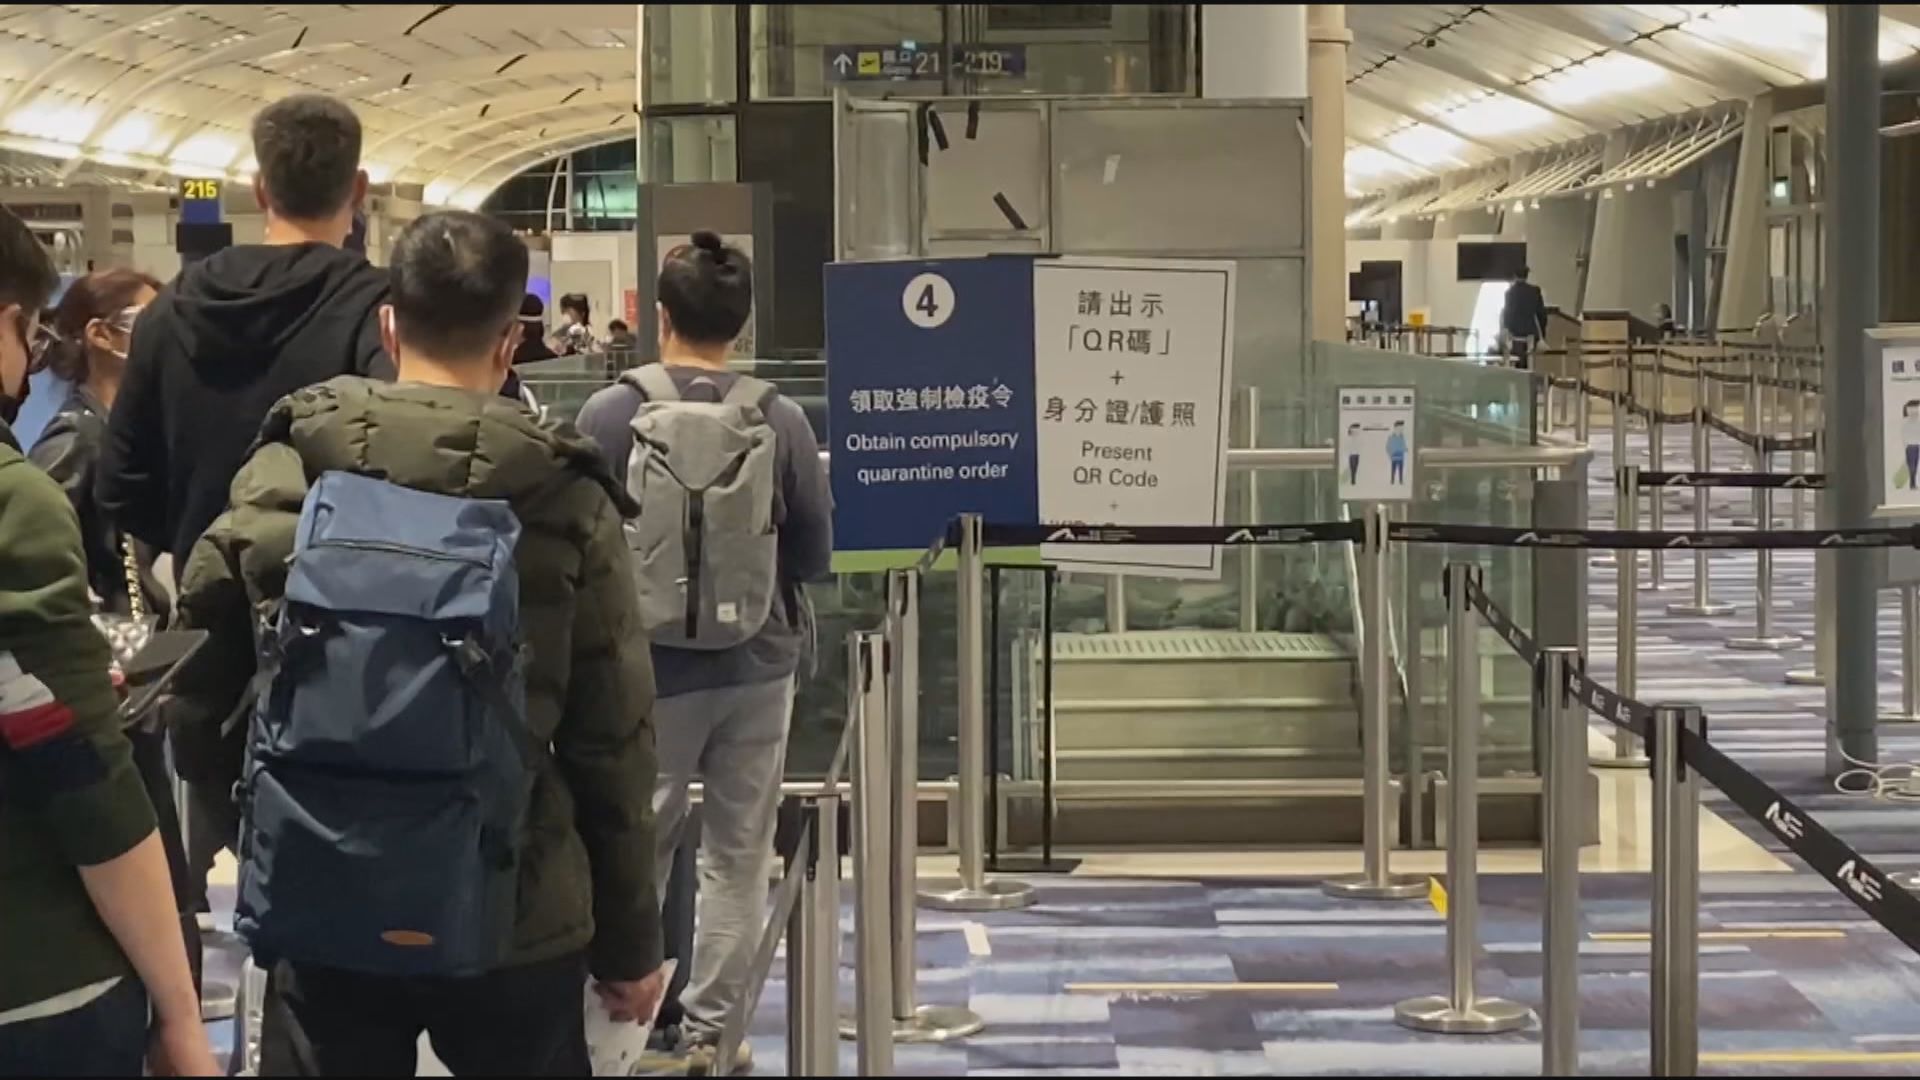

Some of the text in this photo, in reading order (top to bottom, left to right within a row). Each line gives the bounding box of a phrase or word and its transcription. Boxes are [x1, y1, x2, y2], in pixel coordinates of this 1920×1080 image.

[183, 180, 217, 198] 216
[916, 284, 939, 317] 4
[1077, 290, 1164, 318] 請出示
[849, 384, 1013, 413] 領取強制檢疫令
[846, 430, 1019, 452] Obtain compulsory
[1081, 440, 1153, 461] Present
[857, 460, 1009, 486] quarantine order
[1073, 466, 1158, 487] QR Code
